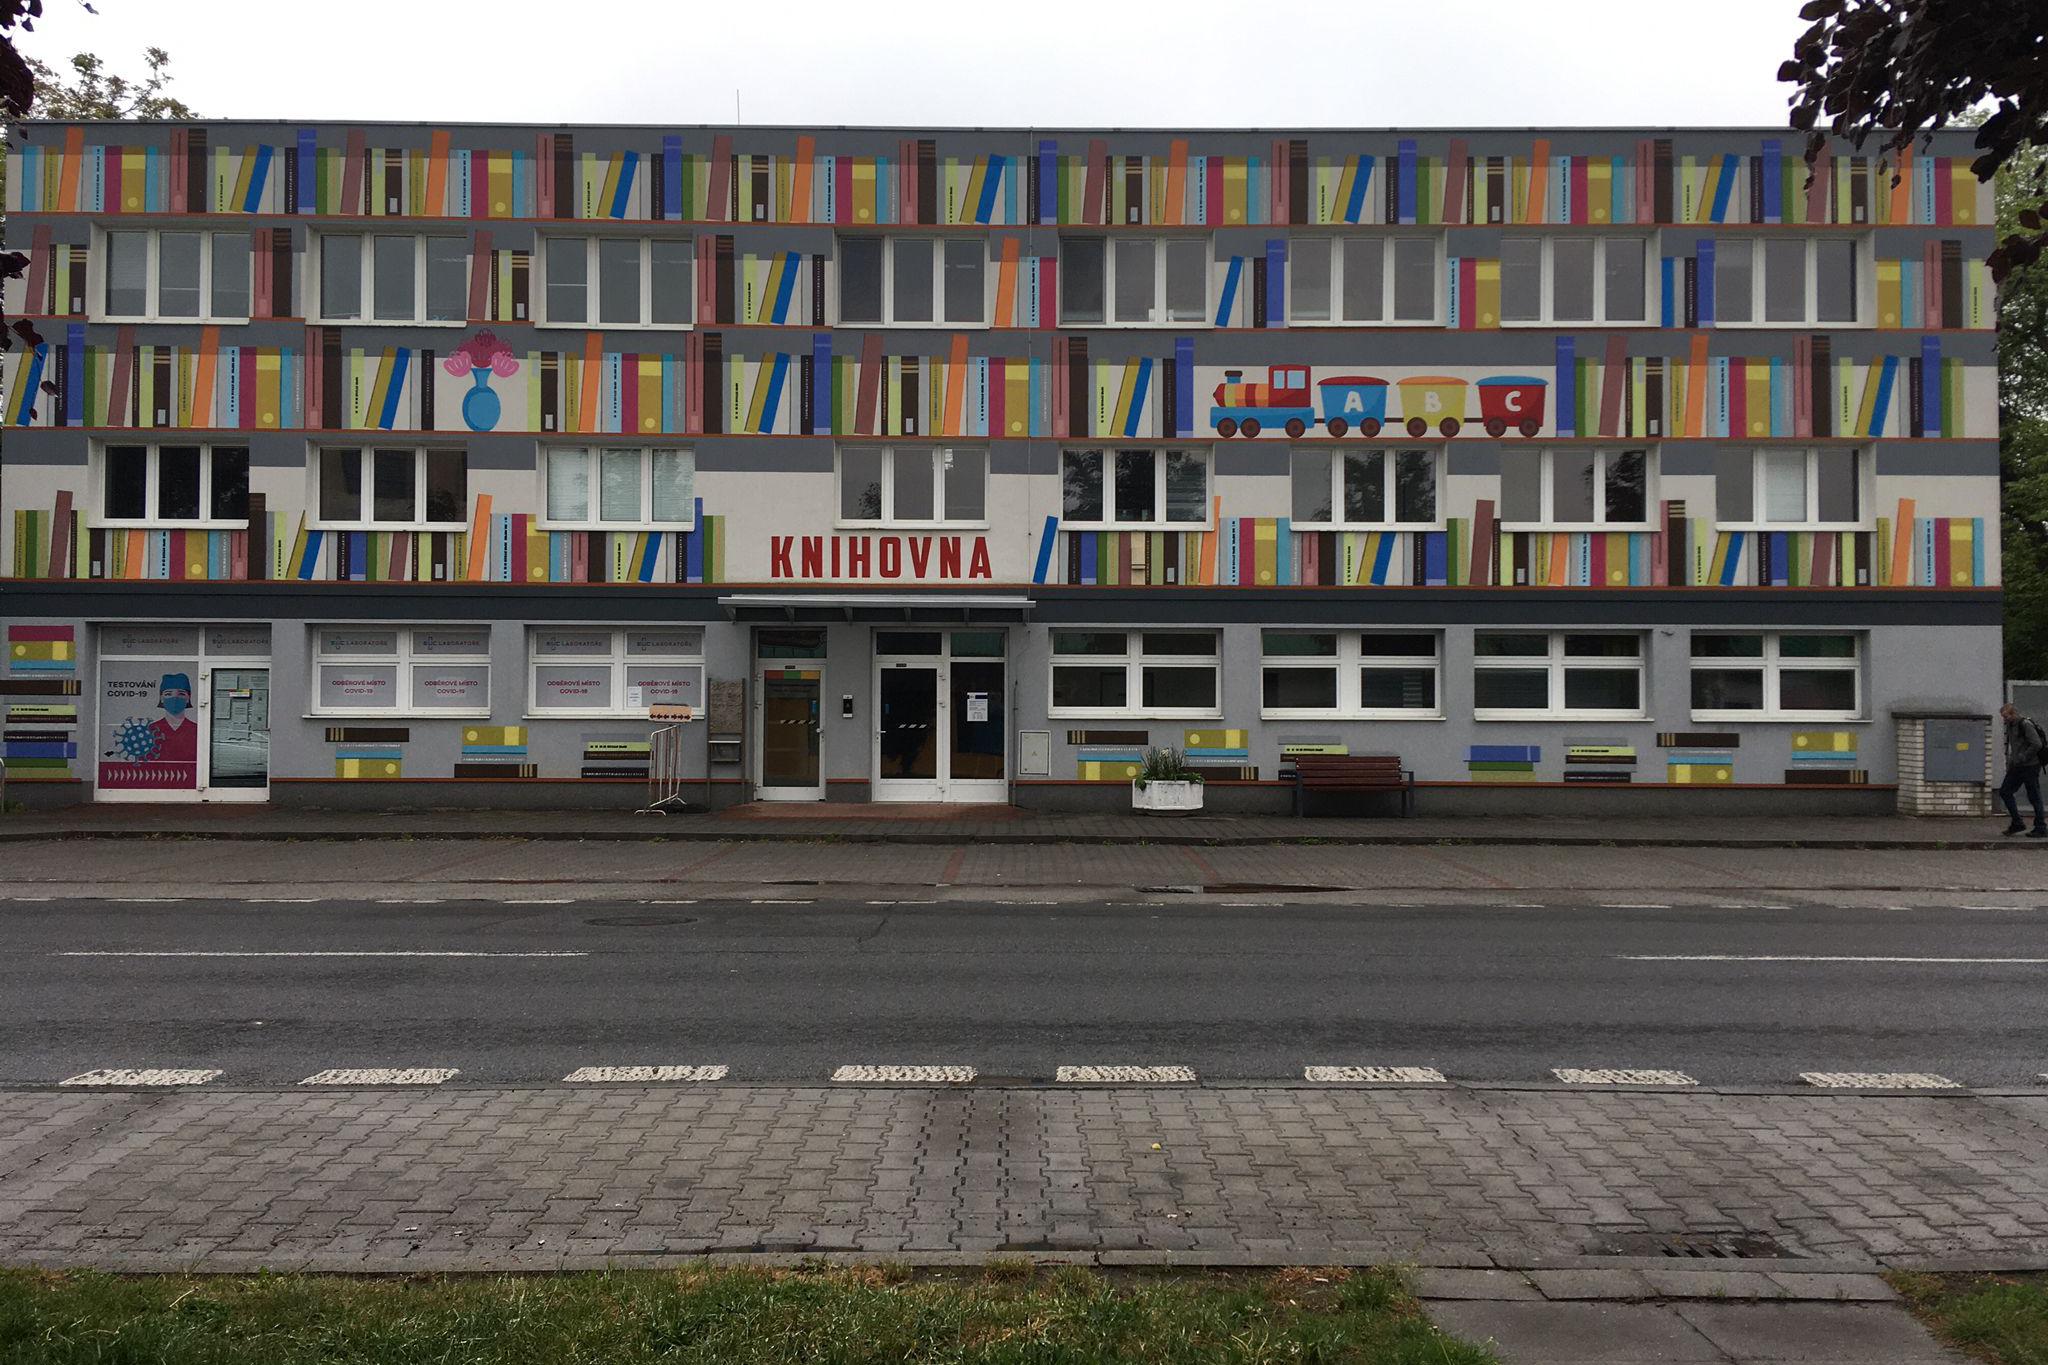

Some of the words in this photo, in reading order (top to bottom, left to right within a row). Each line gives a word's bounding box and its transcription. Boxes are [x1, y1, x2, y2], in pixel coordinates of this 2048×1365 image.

[1344, 391, 1364, 412] A
[1424, 391, 1442, 412] B
[1504, 390, 1522, 412] C
[771, 536, 992, 578] KNIHOVNA
[108, 680, 156, 688] TESTOVÁNÍ
